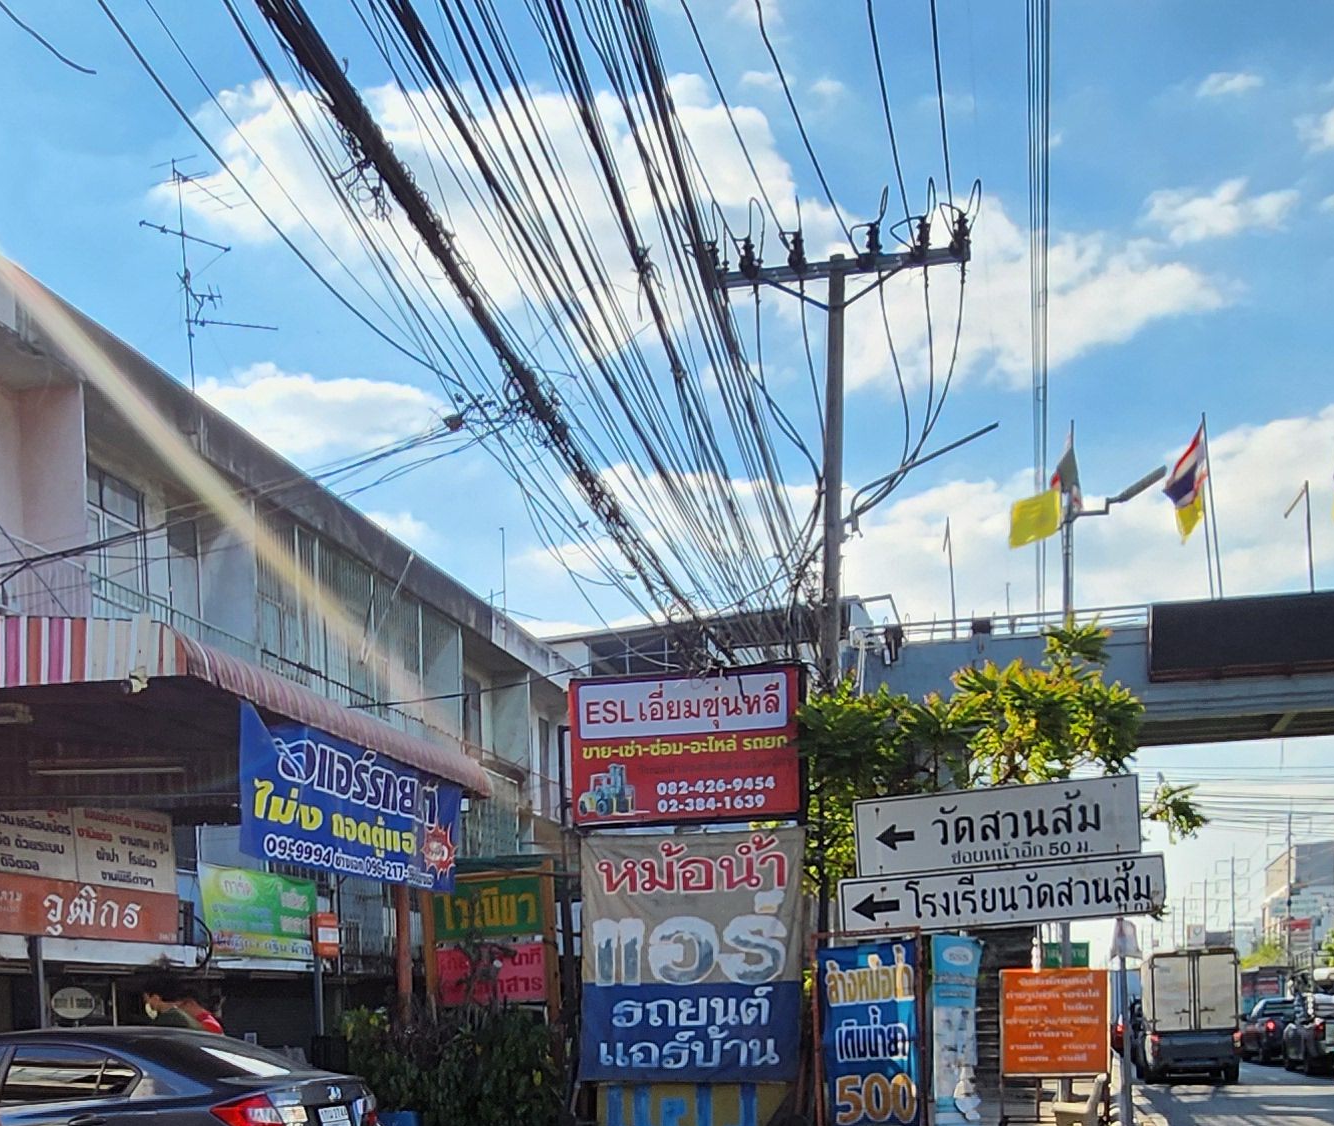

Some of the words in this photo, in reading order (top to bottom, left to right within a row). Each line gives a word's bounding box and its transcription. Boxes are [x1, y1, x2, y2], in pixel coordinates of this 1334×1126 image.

[586, 700, 634, 725] ESL
[656, 775, 776, 796] 082-426-9454
[657, 794, 765, 814] 02-384-1639
[931, 789, 1102, 846] วัดสวนส้ม
[597, 834, 788, 895] หม้อน้ำ
[1049, 842, 1071, 856] 50
[904, 861, 1153, 920] โรงเรียนวัดสวนส้ม
[592, 890, 788, 987] แอร์
[612, 986, 773, 1027] รถยนต์
[599, 1025, 780, 1069] แอร์บ้าน
[835, 1073, 916, 1125] 500
